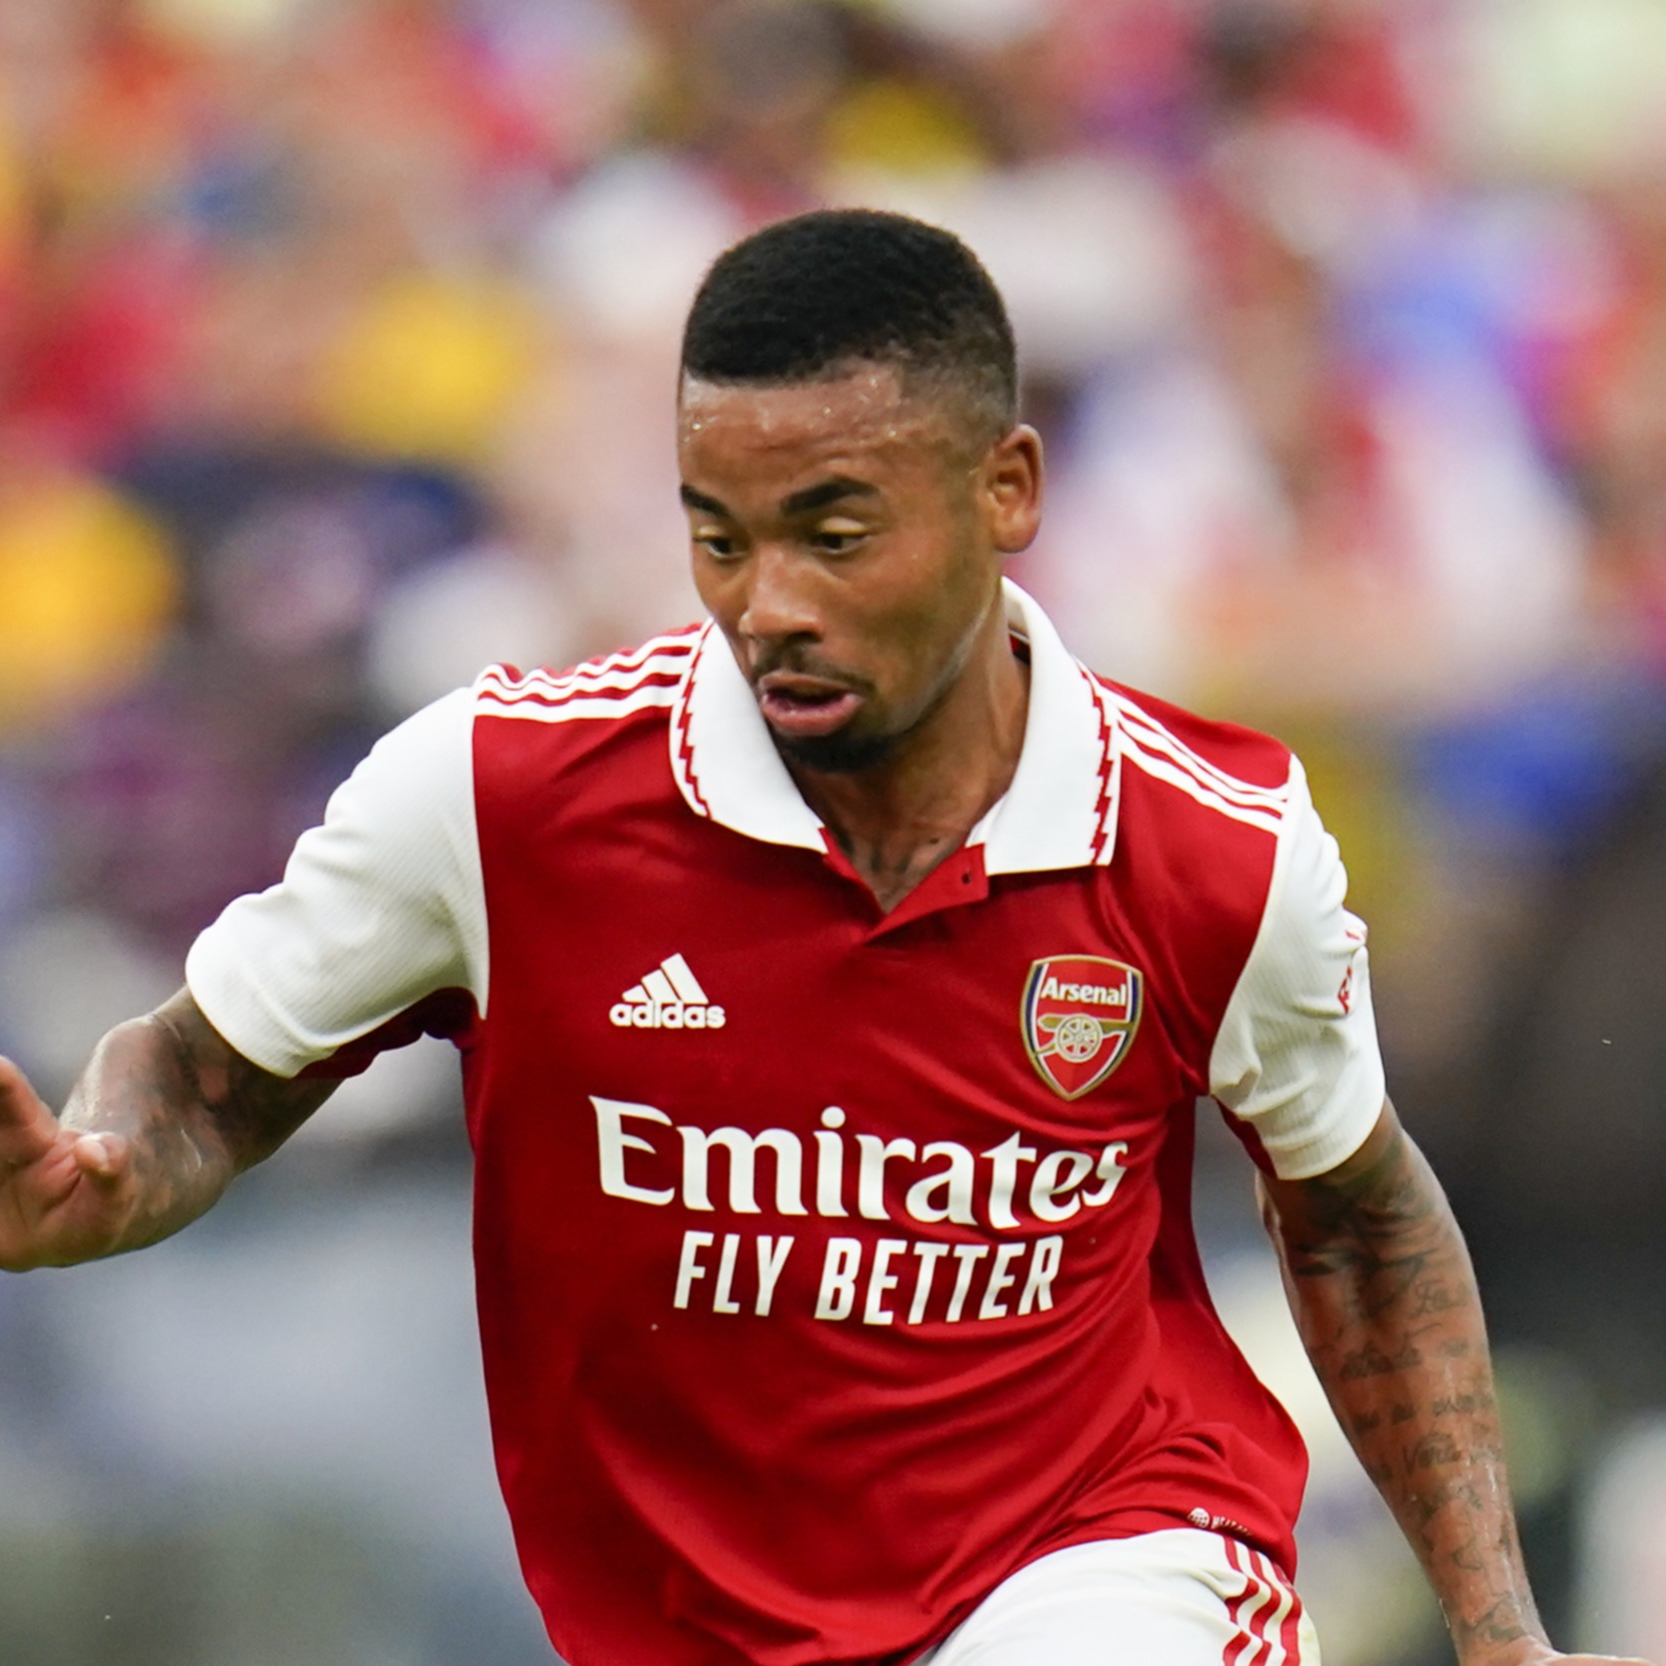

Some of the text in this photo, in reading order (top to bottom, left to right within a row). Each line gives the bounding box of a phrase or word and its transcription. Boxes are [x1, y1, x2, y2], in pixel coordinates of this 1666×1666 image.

[609, 1000, 726, 1030] adidas
[1040, 977, 1127, 1006] Arsenal
[588, 1095, 1128, 1229] Emirates
[673, 1230, 1064, 1326] FLY BETTER
